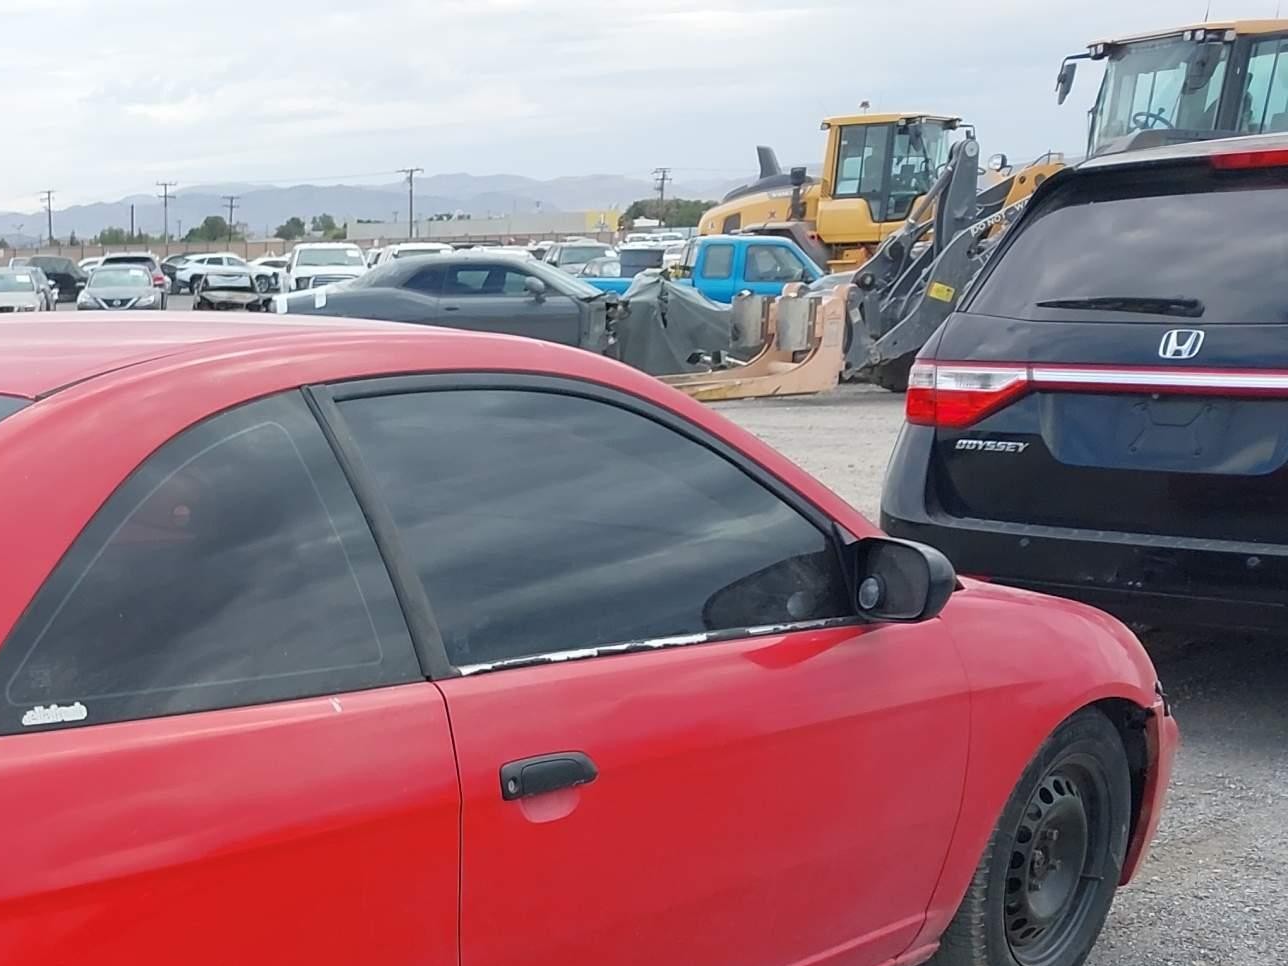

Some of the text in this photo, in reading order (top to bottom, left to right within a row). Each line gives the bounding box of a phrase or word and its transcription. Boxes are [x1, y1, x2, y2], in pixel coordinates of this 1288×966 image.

[970, 224, 986, 237] DO
[987, 211, 1007, 226] NOT
[954, 438, 1030, 453] ODYSSEY
